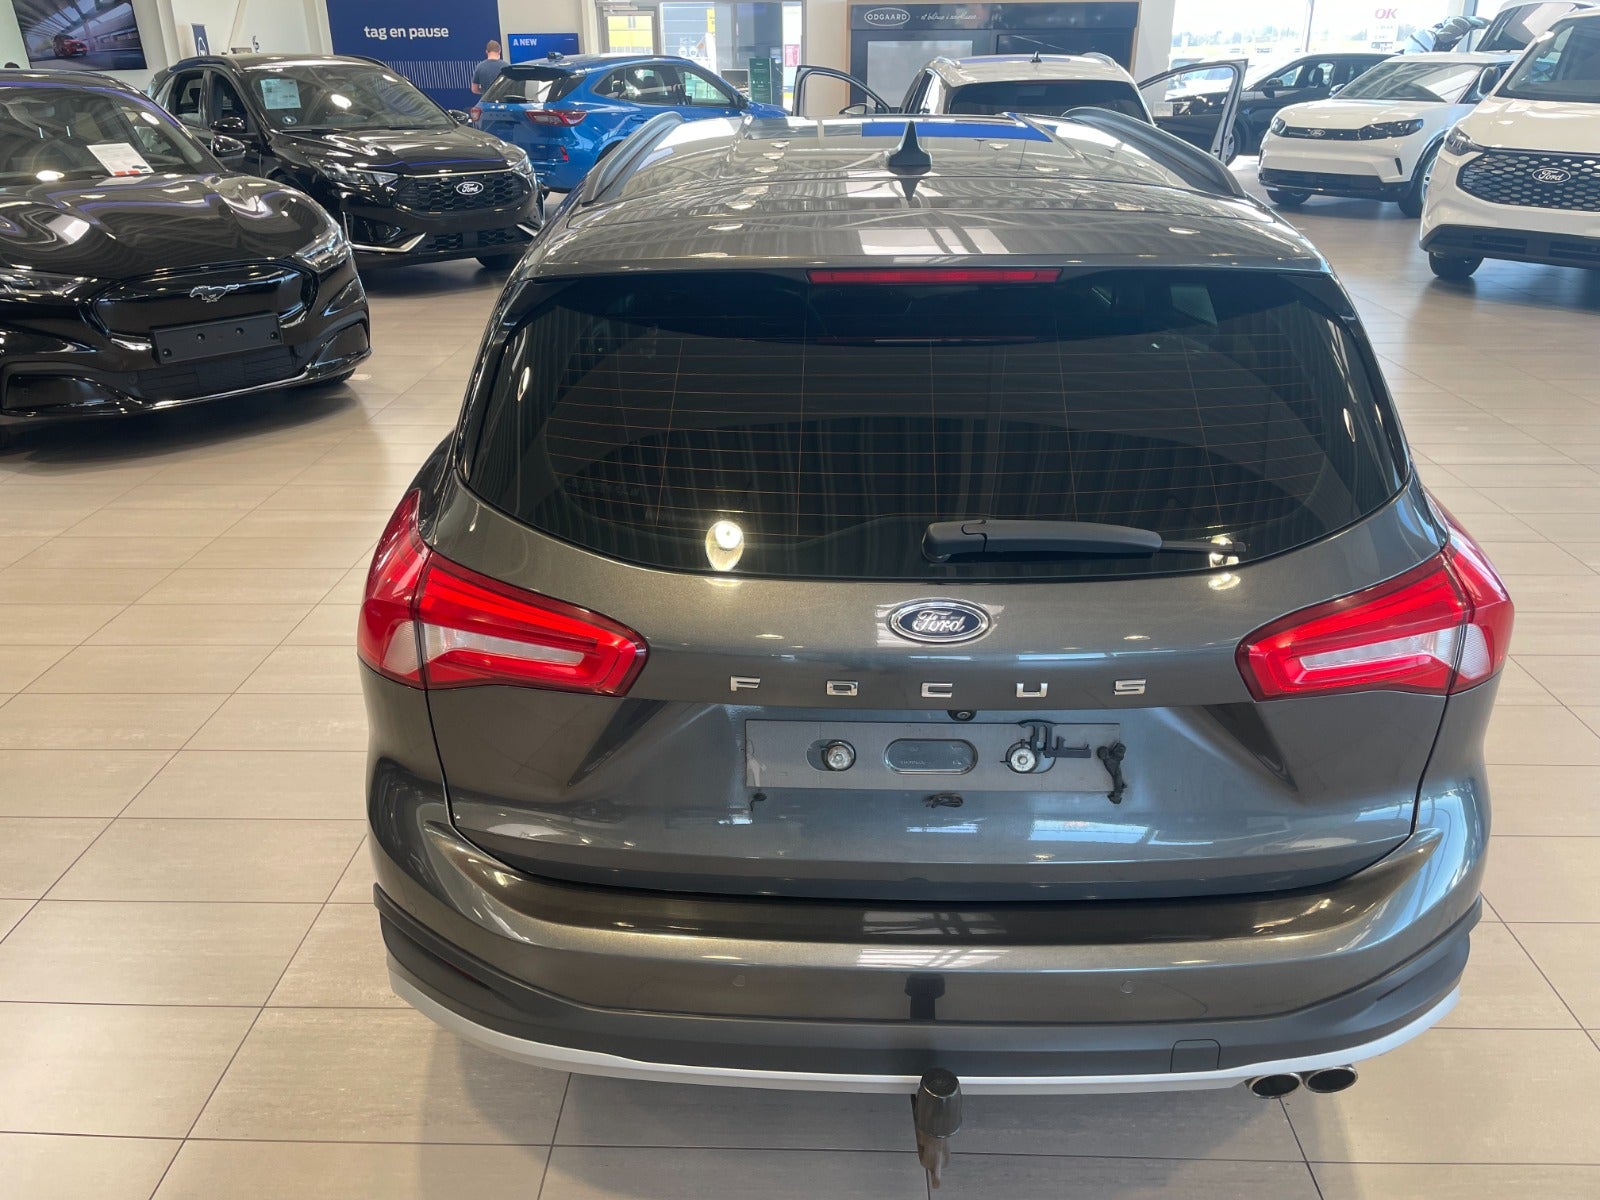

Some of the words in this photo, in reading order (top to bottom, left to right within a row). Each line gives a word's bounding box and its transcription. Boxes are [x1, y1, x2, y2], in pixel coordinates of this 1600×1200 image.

[364, 26, 387, 40] tag
[389, 29, 406, 38] en
[409, 28, 449, 40] pause
[513, 38, 520, 46] A
[520, 38, 537, 46] NEW
[1538, 170, 1565, 180] Ford
[911, 610, 966, 632] Ford
[730, 676, 1146, 698] FOCUS
